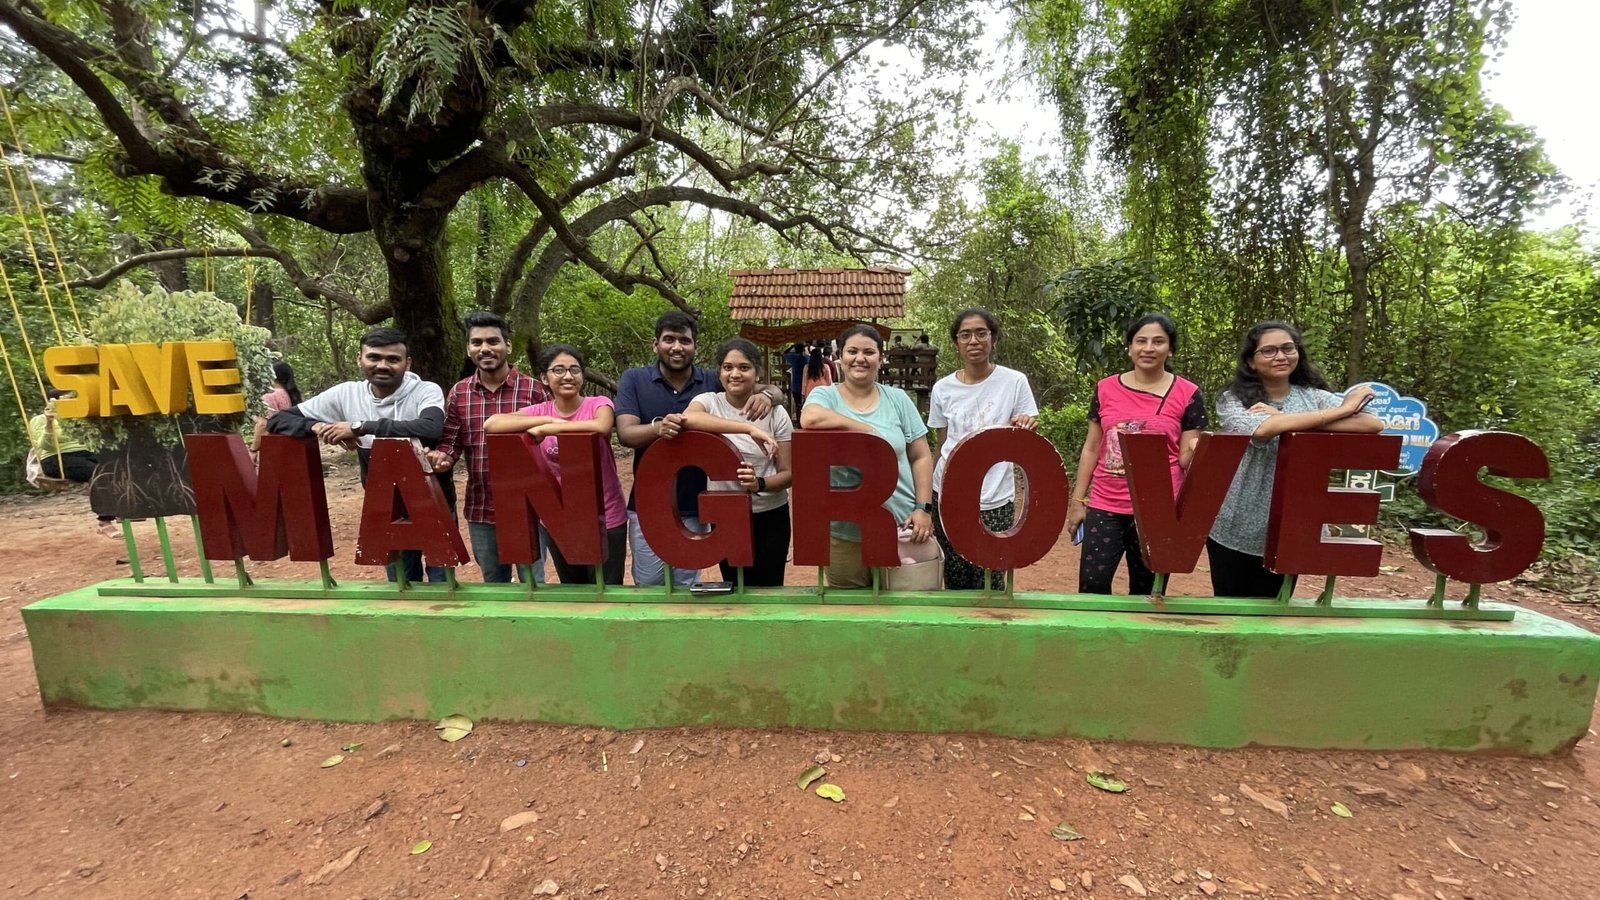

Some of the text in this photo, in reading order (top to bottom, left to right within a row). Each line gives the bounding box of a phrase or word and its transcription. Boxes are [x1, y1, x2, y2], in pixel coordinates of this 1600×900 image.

[43, 340, 245, 418] SAVE
[1410, 434, 1432, 447] WALK
[187, 427, 1550, 583] MANGROVES
